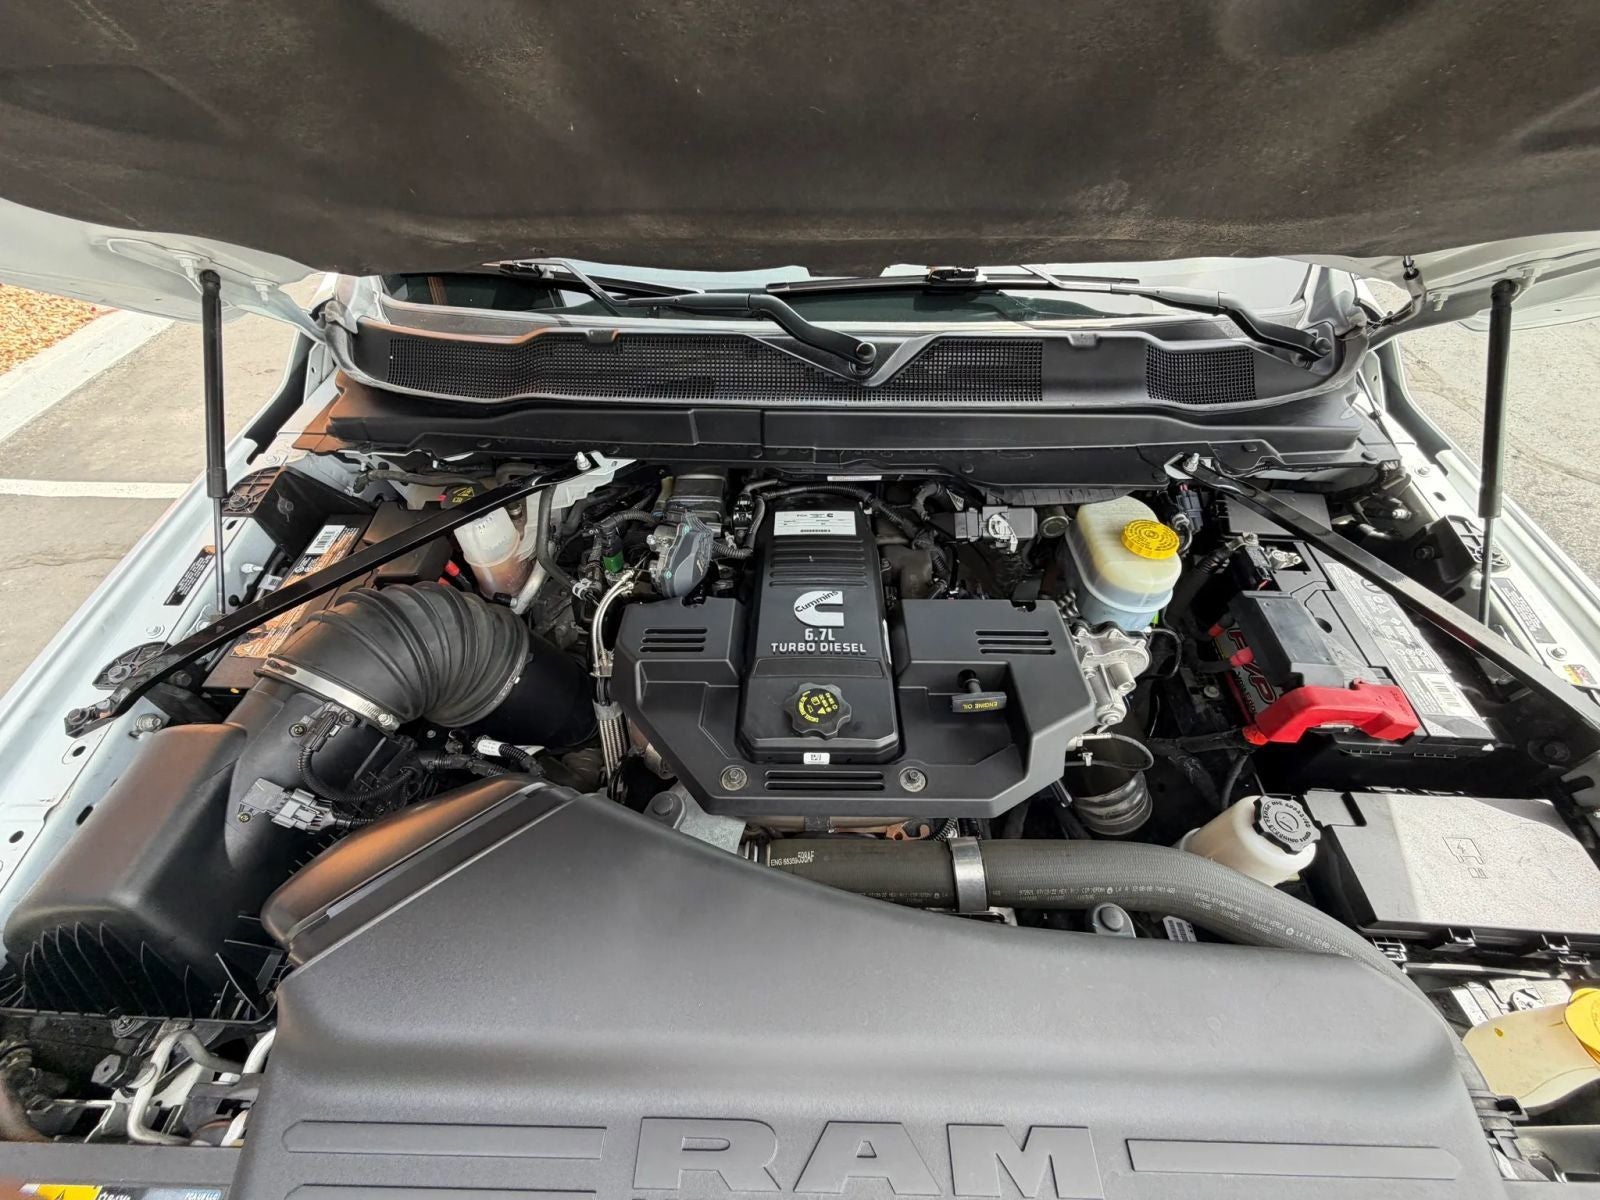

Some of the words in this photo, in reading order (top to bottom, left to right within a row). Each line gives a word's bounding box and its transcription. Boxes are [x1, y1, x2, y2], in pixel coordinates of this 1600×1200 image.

[794, 590, 839, 612] Cummins
[804, 628, 836, 641] 6.7L
[771, 642, 816, 652] TURBO
[820, 642, 867, 653] DIESEL
[974, 701, 998, 709] ENGINE
[632, 1116, 1105, 1199] RAM
